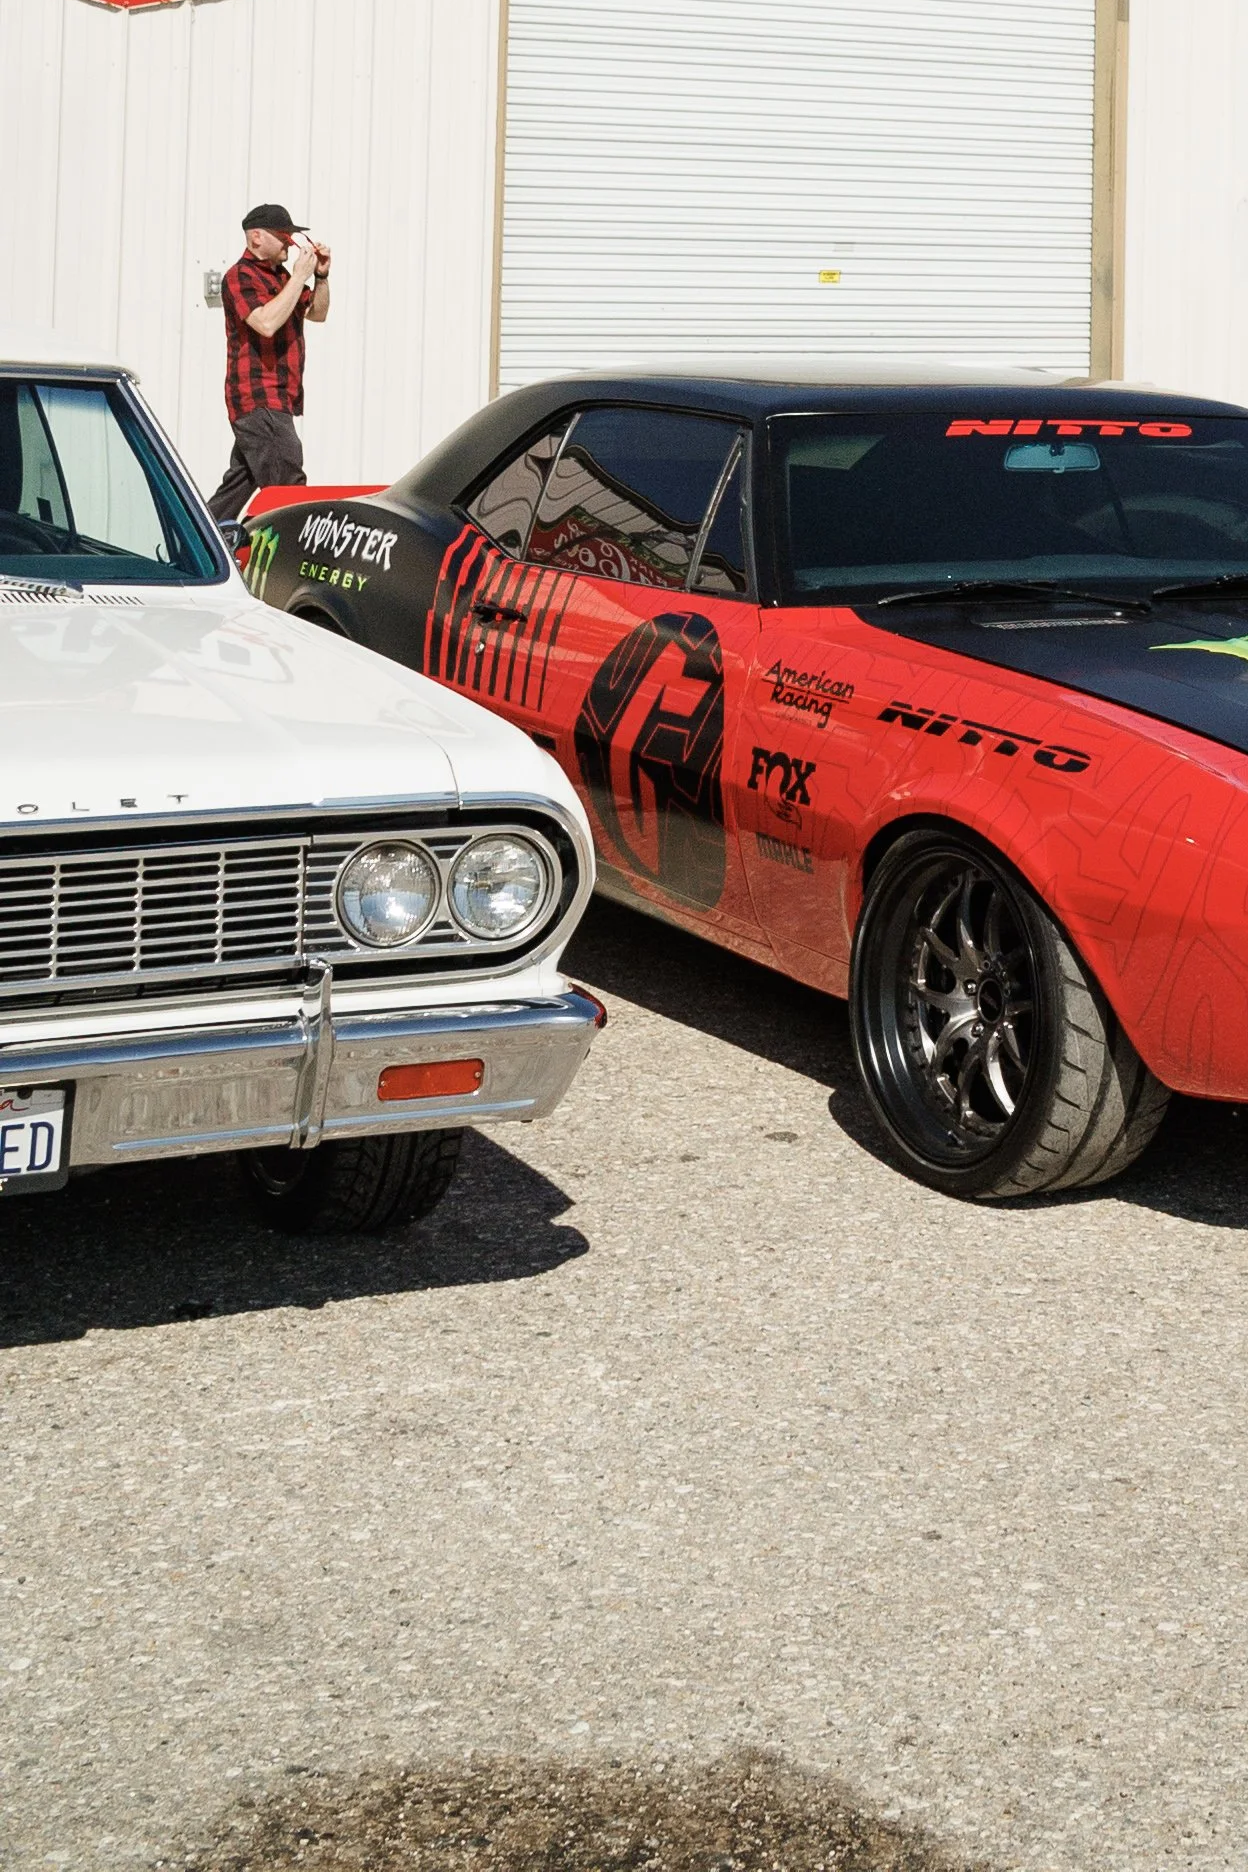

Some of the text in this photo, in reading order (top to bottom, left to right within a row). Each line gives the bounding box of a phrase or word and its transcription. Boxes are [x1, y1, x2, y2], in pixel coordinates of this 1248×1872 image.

[945, 419, 1193, 437] NITTO
[300, 561, 368, 592] ENERGY
[764, 658, 855, 699] American
[770, 683, 833, 729] Racing
[876, 700, 1093, 773] NITTO
[747, 746, 817, 808] FOX
